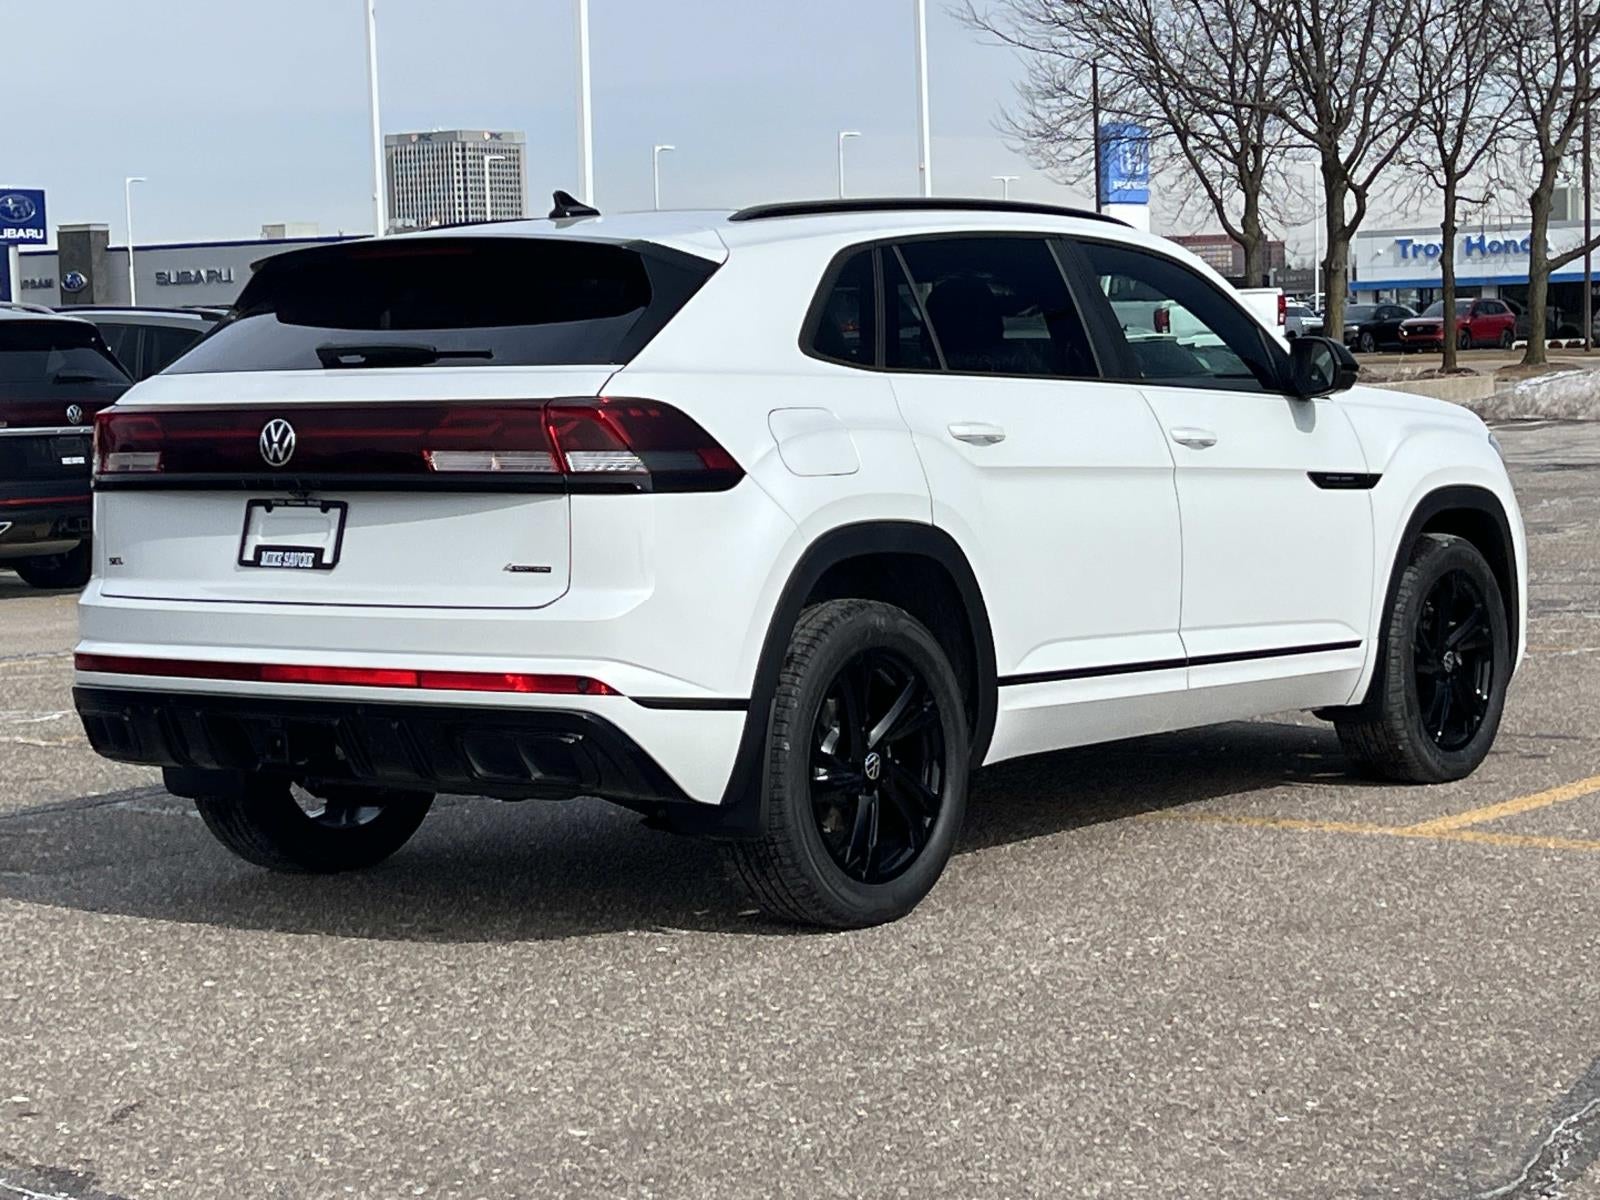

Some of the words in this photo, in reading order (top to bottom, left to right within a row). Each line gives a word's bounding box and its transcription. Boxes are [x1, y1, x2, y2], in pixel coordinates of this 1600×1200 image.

[0, 228, 44, 239] UBARU
[1394, 238, 1443, 259] Tro
[1465, 234, 1552, 257] Hon
[155, 269, 234, 286] SUBARU
